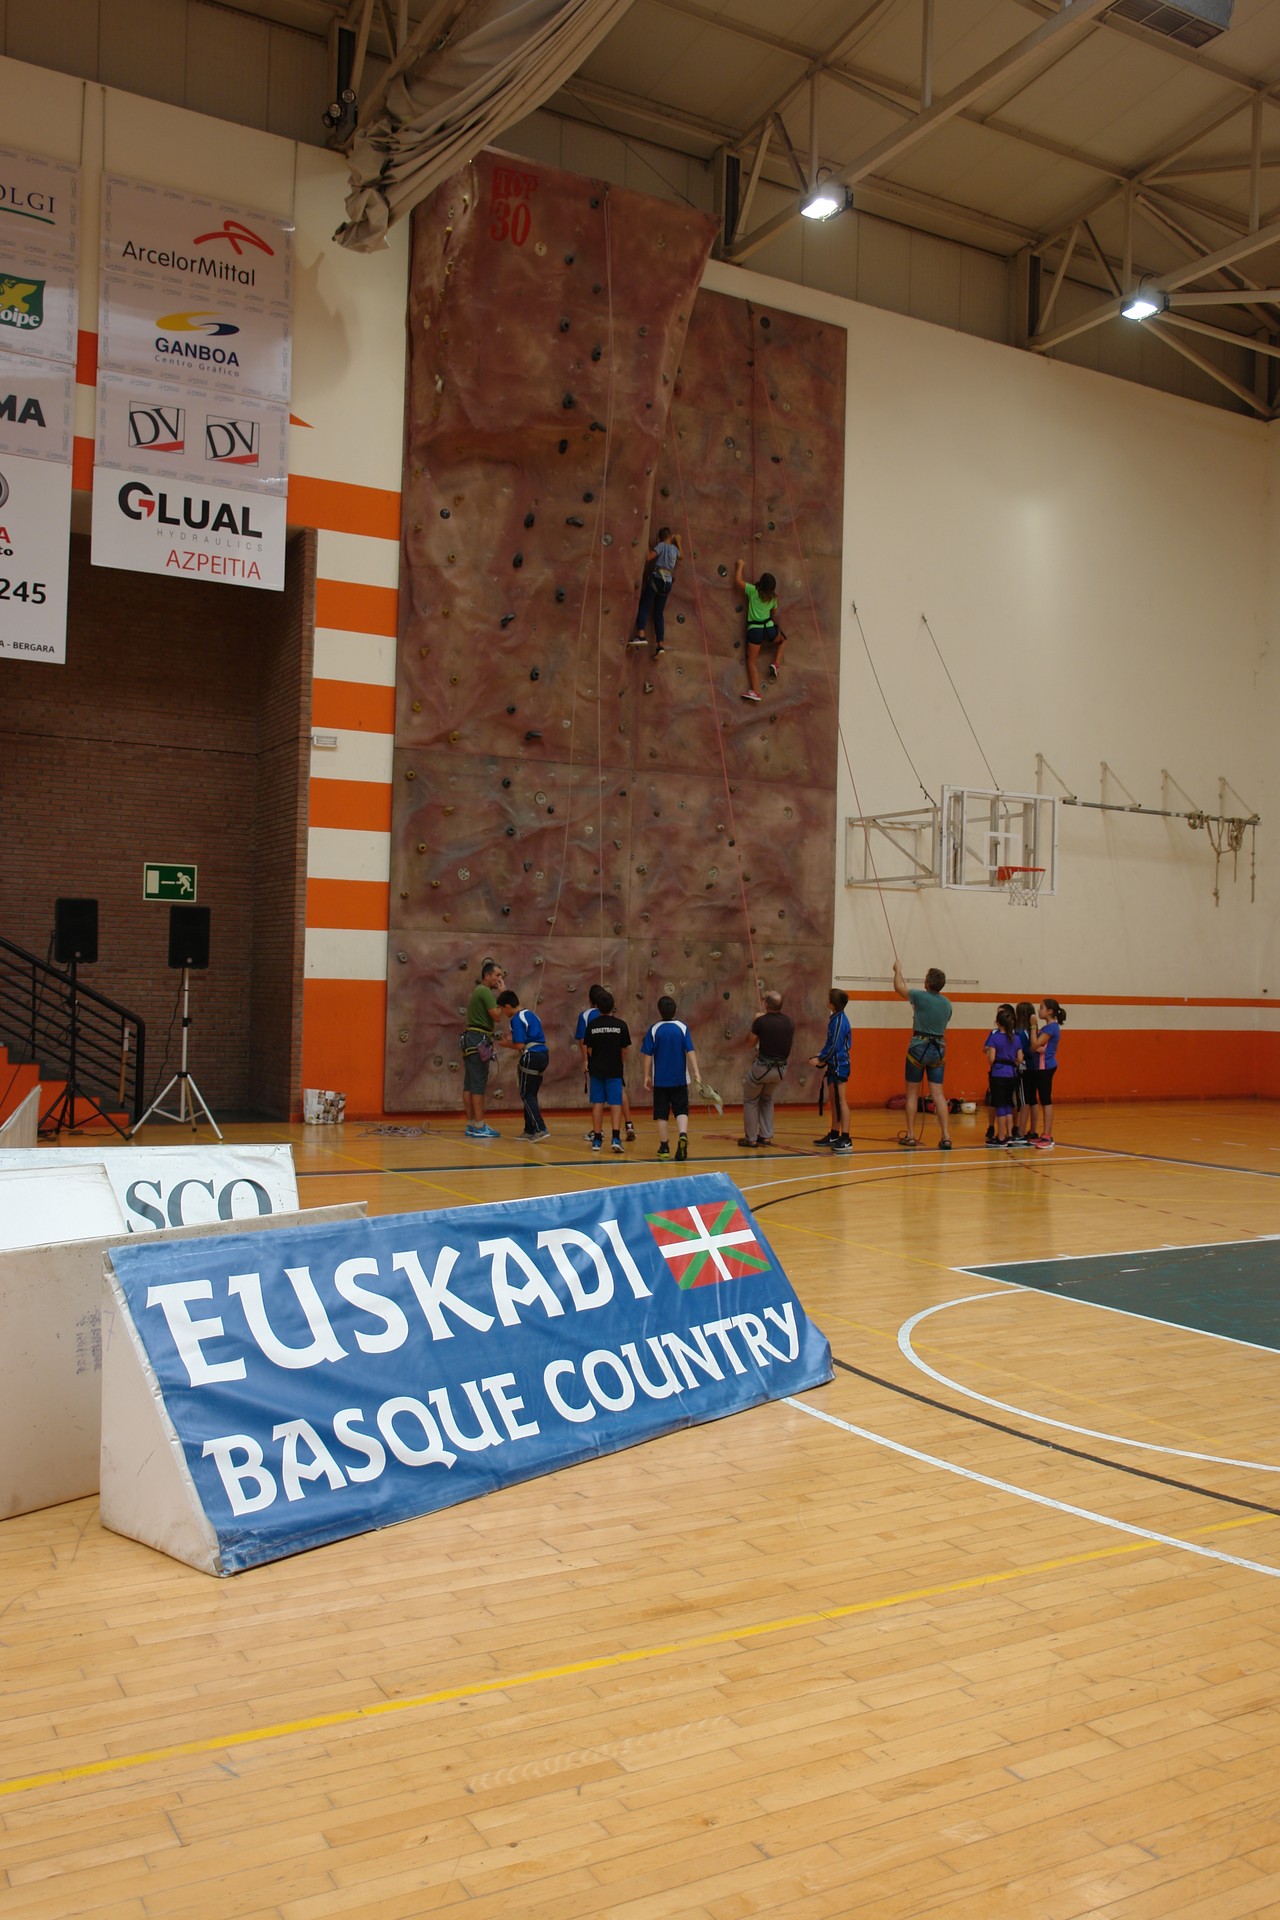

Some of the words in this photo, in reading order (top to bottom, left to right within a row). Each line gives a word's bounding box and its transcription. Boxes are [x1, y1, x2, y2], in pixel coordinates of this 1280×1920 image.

[490, 198, 531, 247] 30
[122, 240, 256, 287] ArcelorMittal
[154, 354, 193, 368] Centro
[155, 337, 240, 367] GANBOA
[118, 481, 263, 538] GLUAL
[156, 528, 263, 552] HYDRAULICS
[166, 549, 261, 580] AZPEITIA
[12, 641, 55, 654] BERGARA
[146, 1219, 653, 1388] EUSKADI
[202, 1372, 541, 1517] BASQUE
[543, 1301, 800, 1423] COUNTRY
